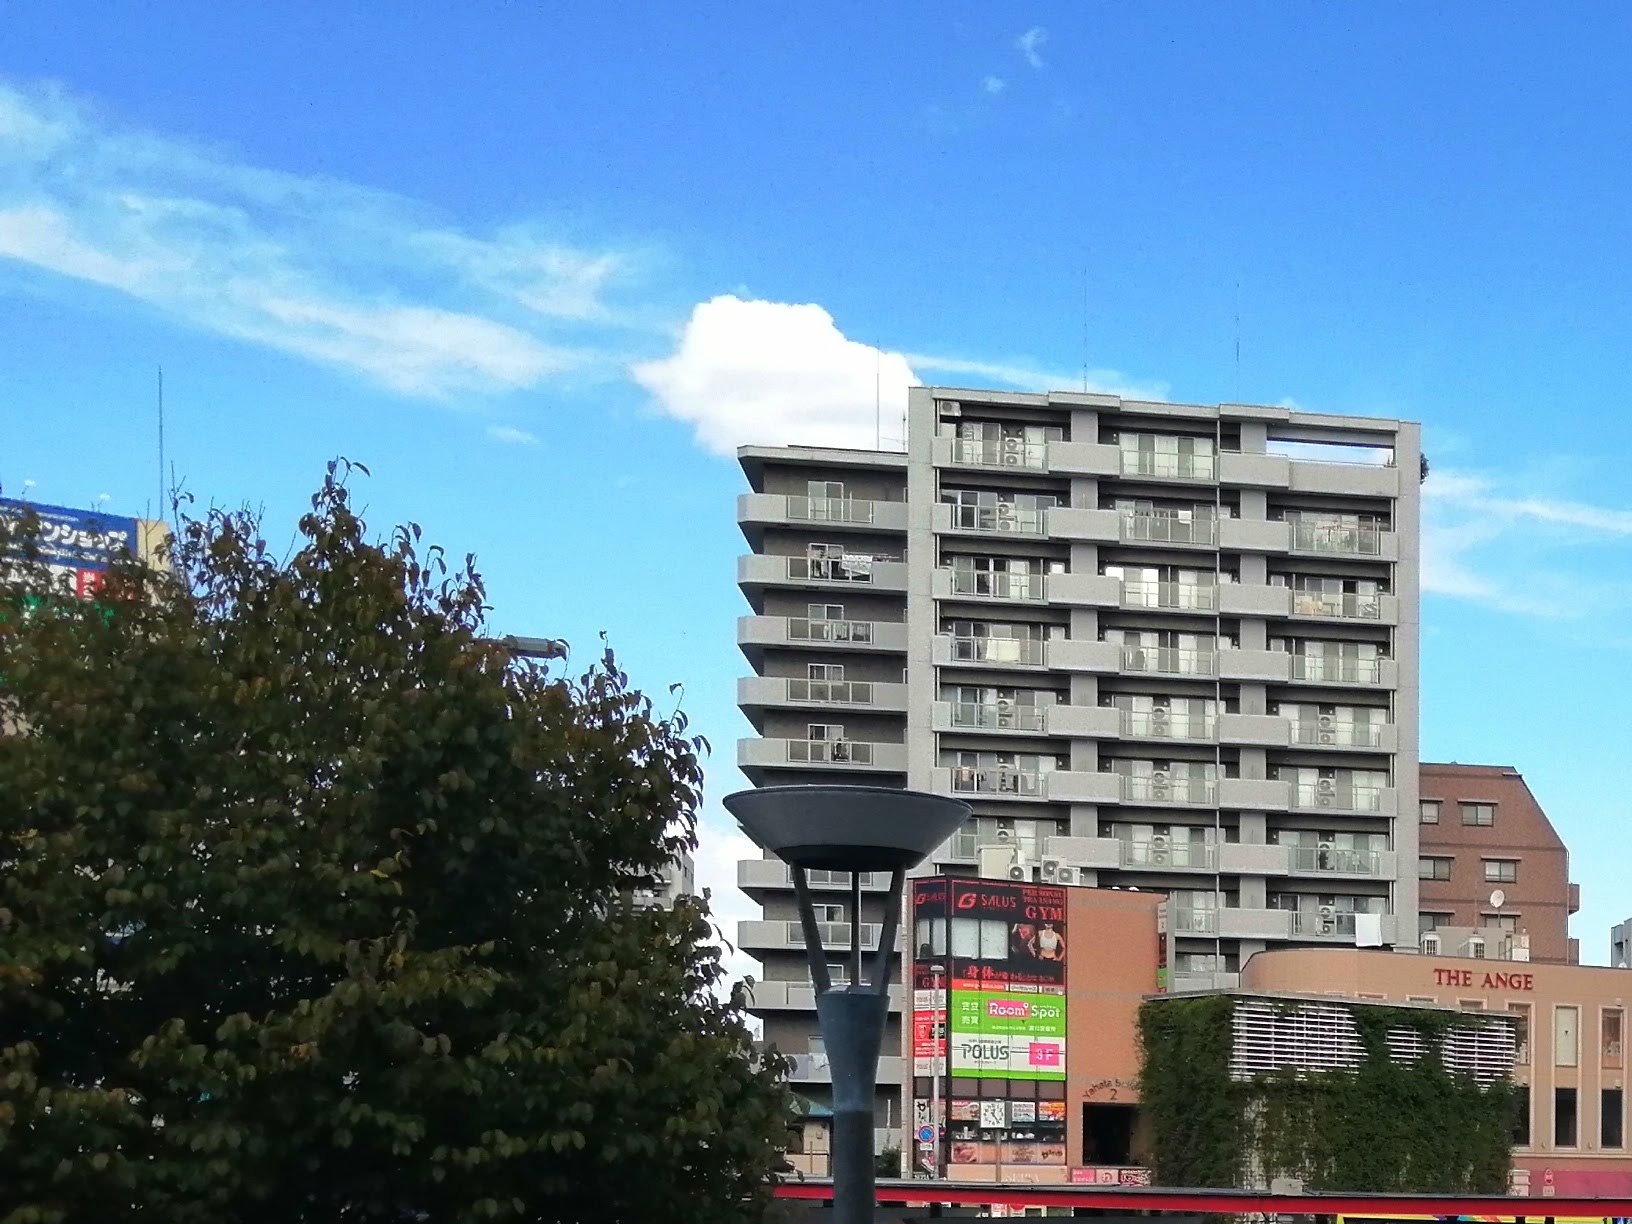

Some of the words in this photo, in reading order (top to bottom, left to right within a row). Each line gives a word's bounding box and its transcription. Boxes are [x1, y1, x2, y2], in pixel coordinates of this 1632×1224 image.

[981, 894, 1016, 907] SALUS
[1025, 906, 1063, 920] GYM
[1434, 968, 1472, 987] THE
[1481, 972, 1533, 990] ANGE
[989, 1002, 1026, 1016] Room
[1031, 1005, 1060, 1019] Spot
[961, 1044, 1009, 1060] POLUS
[1082, 1080, 1112, 1098] Yahata
[1110, 1089, 1117, 1100] 2
